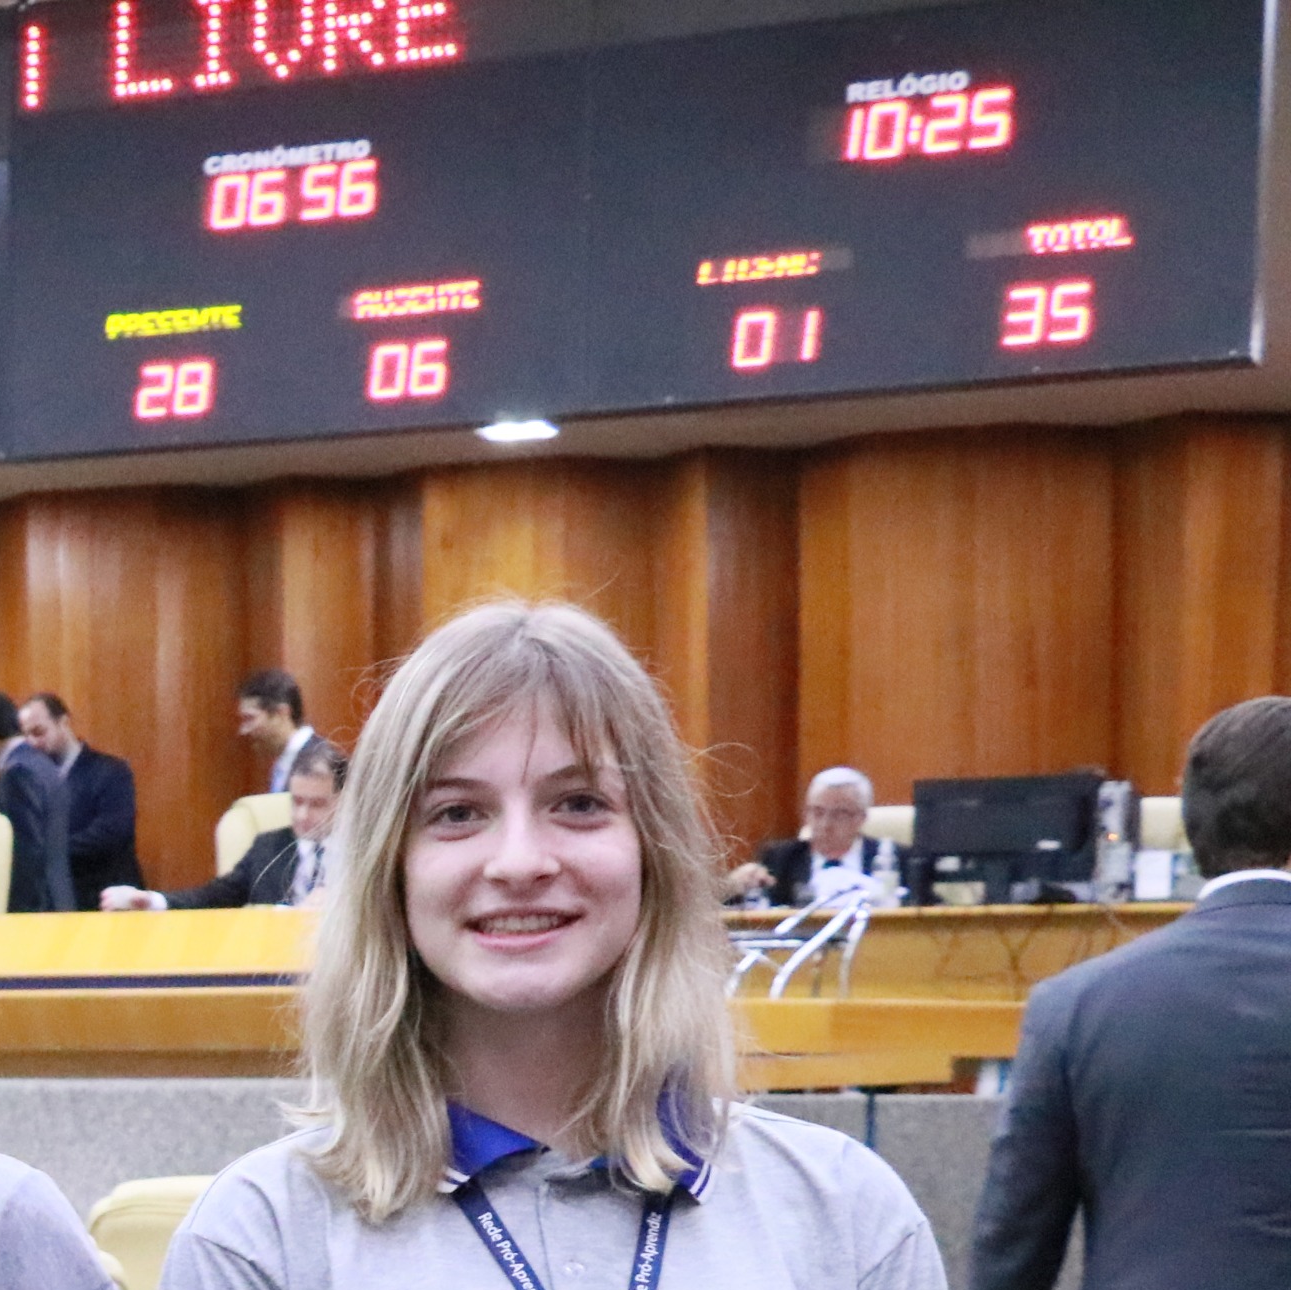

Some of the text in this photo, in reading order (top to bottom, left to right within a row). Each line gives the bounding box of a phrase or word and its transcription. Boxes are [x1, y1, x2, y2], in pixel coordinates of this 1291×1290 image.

[846, 70, 970, 102] RELÓGIO
[846, 86, 1015, 160] 10:25
[207, 160, 378, 231] 06 56
[104, 304, 242, 339] PRESENTE
[353, 281, 480, 320] AUSENTE
[1000, 279, 1093, 347] 35
[731, 309, 822, 369] 01
[134, 359, 214, 420] 28
[365, 340, 448, 401] 06
[477, 1211, 503, 1242] Rede
[634, 1211, 663, 1283] Pró-Aprendiz
